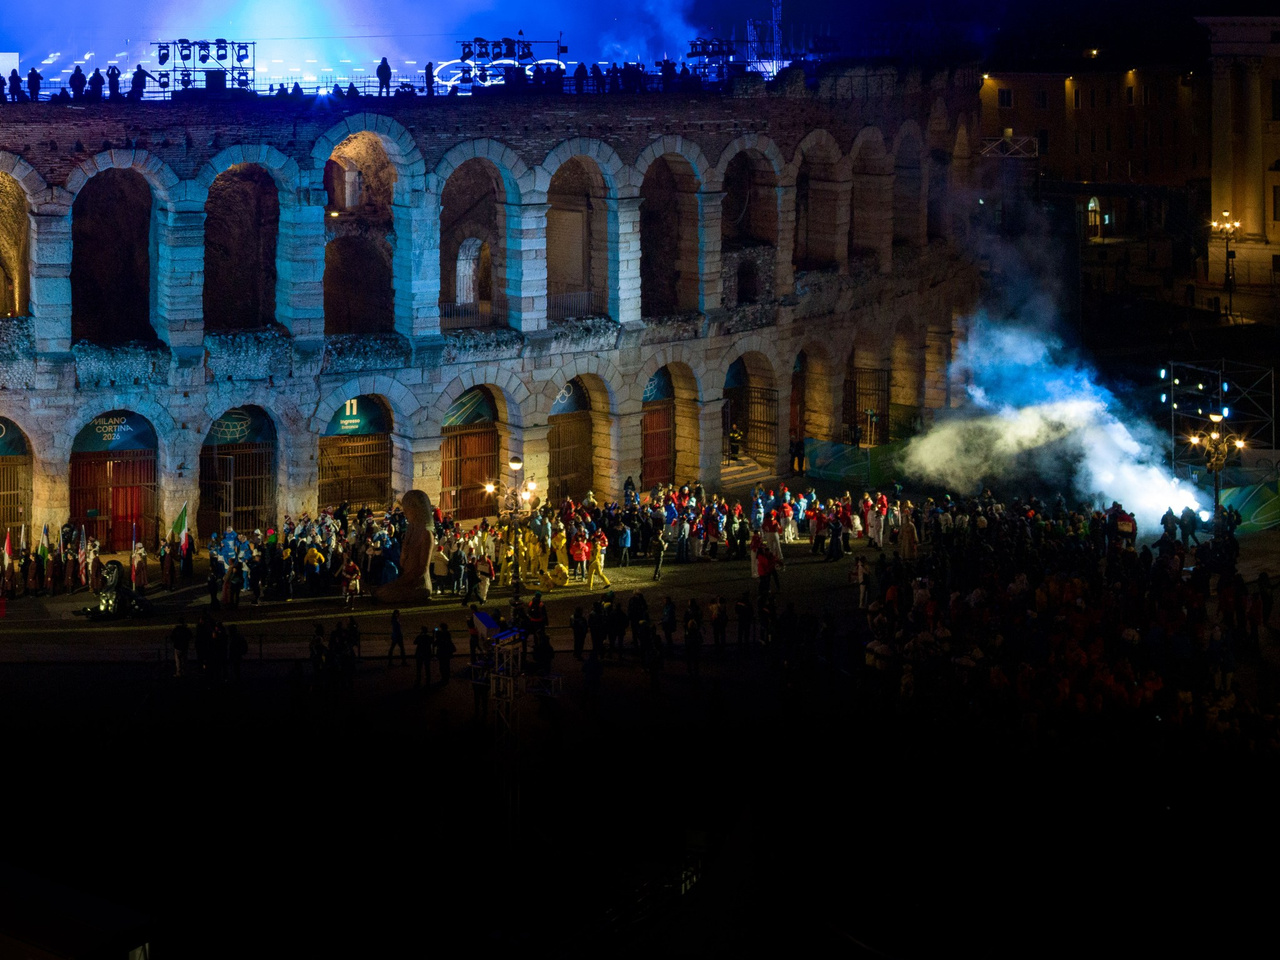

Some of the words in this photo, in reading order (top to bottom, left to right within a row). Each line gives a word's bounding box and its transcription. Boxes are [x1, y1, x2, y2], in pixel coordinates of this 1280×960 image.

[345, 399, 358, 416] 11
[89, 416, 127, 426] MILANO
[95, 424, 134, 433] CORTINA
